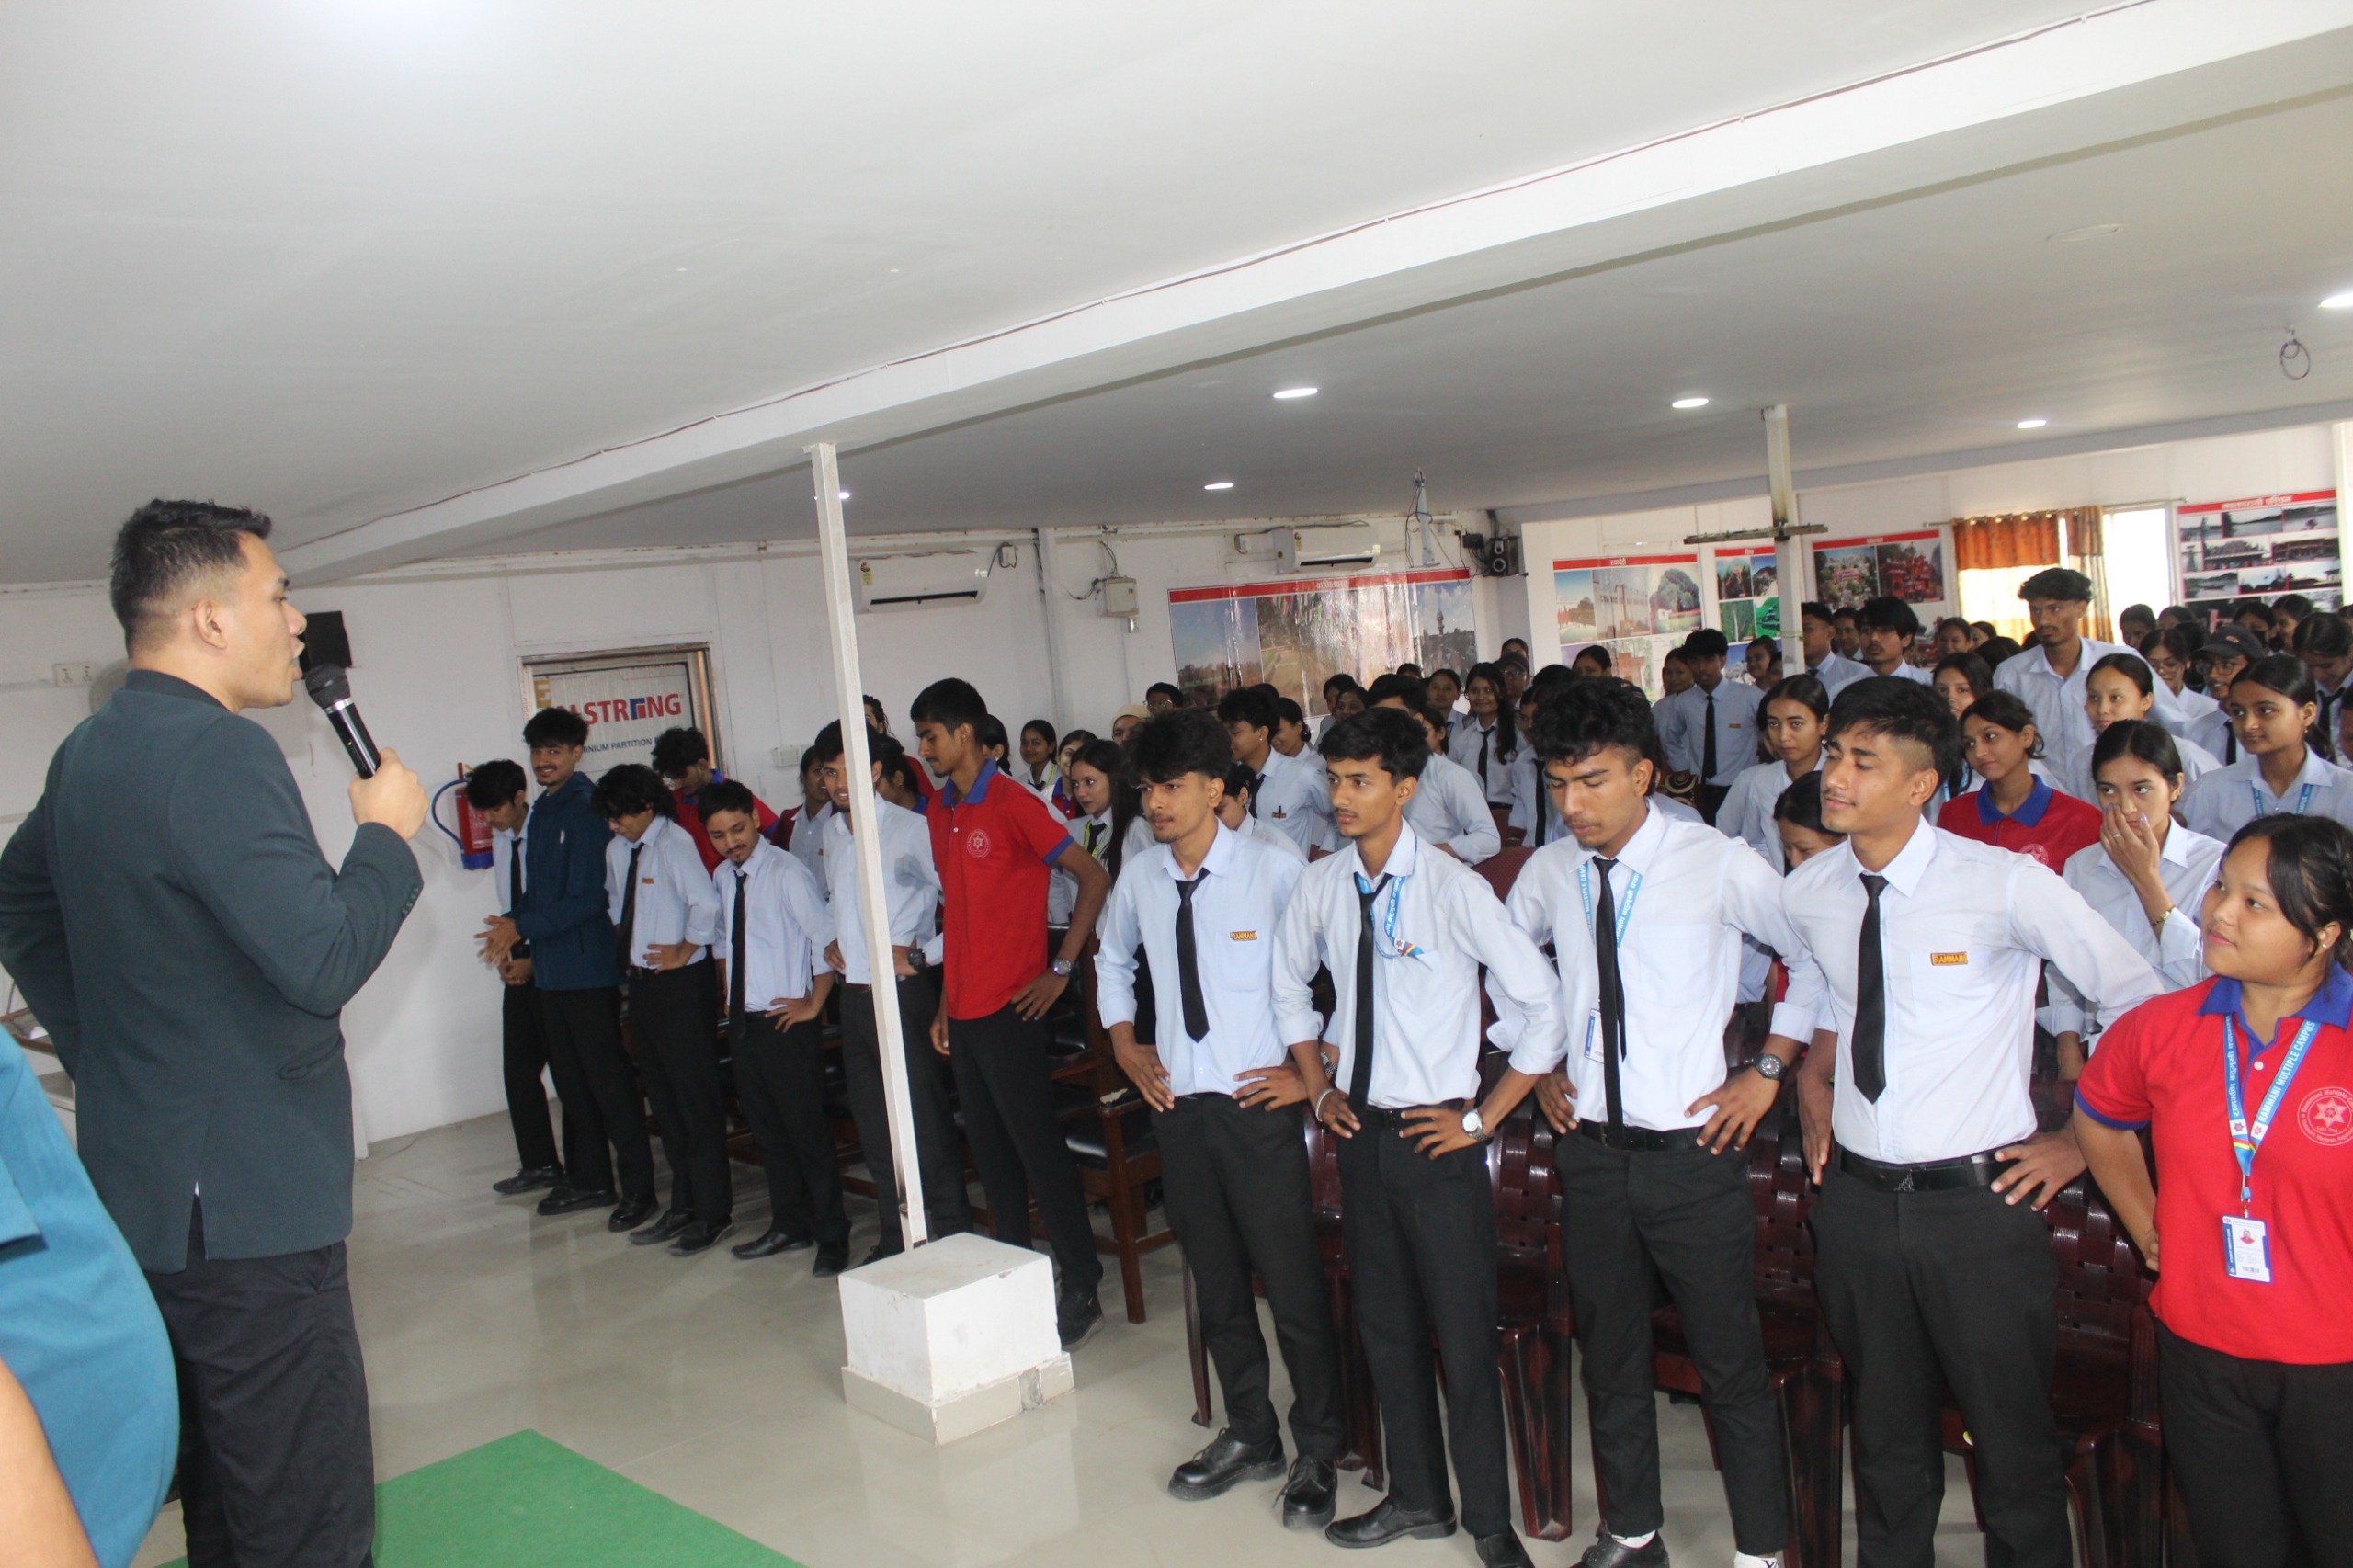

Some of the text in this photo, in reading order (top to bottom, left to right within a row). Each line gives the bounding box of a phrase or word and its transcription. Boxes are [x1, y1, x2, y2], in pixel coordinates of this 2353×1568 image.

[610, 738, 653, 750] PARTITION
[2258, 1020, 2316, 1123] RAMMANI MULTIPLE CAMPUS
